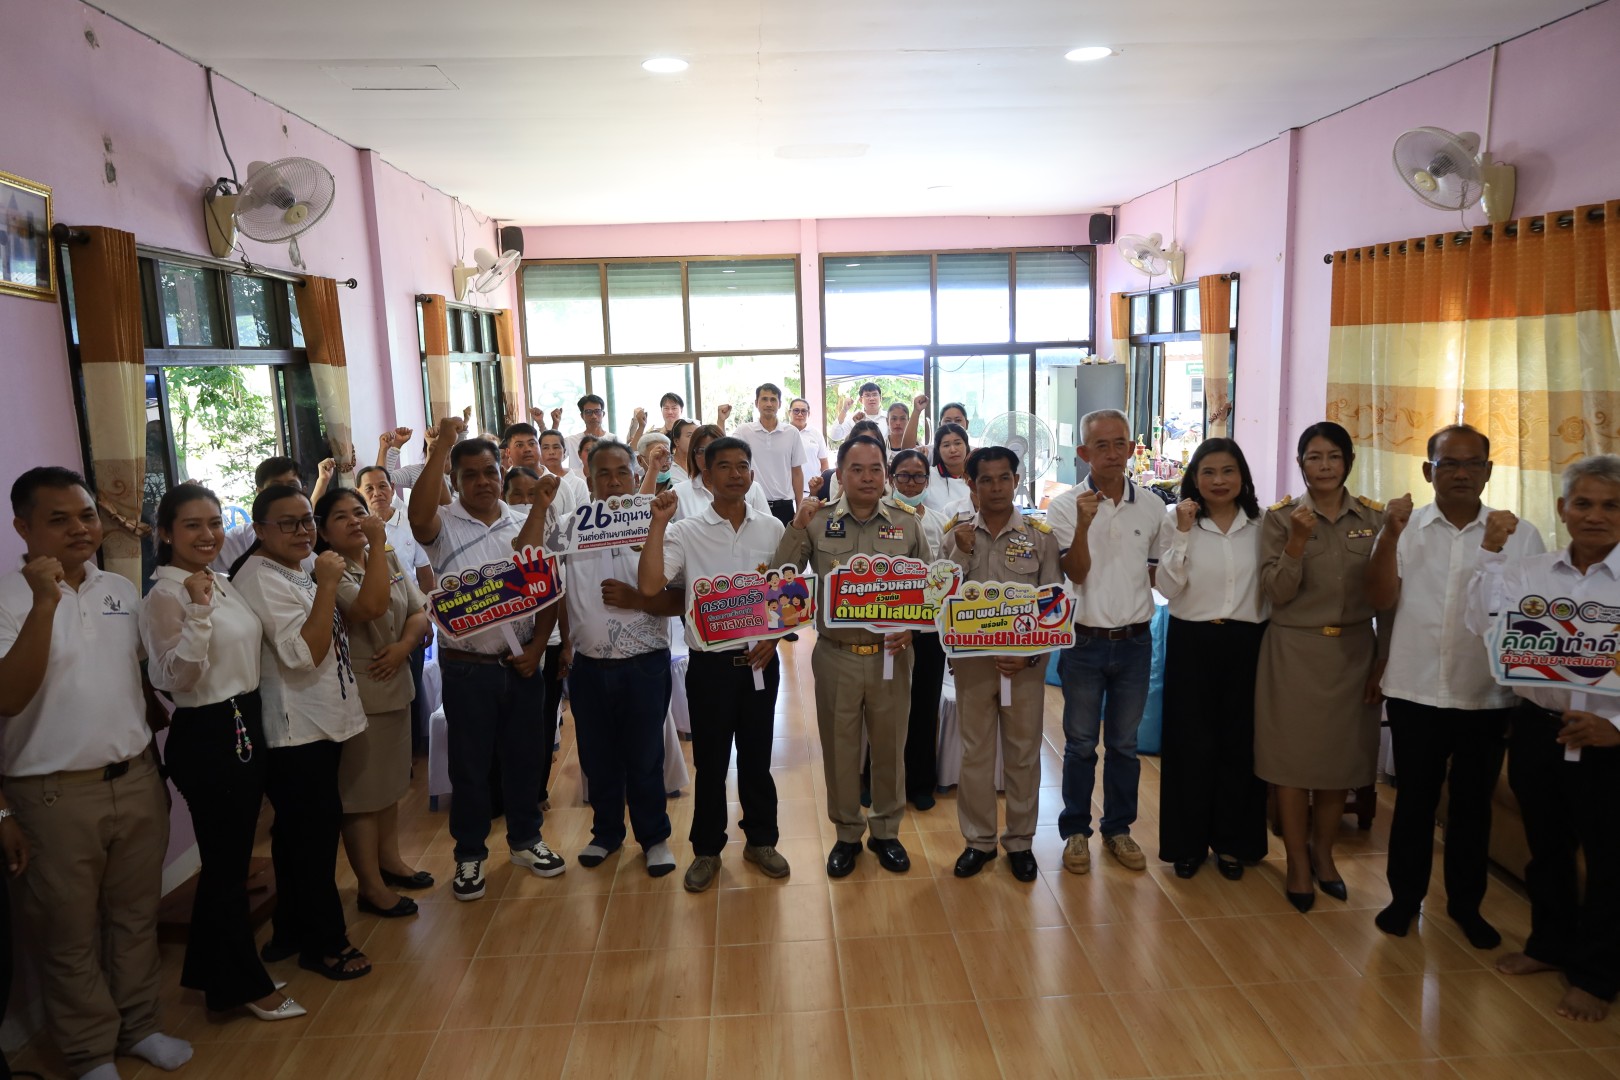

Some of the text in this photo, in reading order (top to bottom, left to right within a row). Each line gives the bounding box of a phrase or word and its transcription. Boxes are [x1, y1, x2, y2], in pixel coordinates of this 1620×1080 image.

[576, 503, 652, 531] 26 มิถุนาย
[436, 578, 505, 613] มุ่งมั่น แก้ไข
[528, 580, 547, 595] NO
[840, 578, 926, 596] รักลูกห่วงหลาน
[701, 589, 764, 614] ครอบครัว
[876, 593, 900, 602] ร่วมกัน
[450, 597, 537, 631] ยาเสพติด
[957, 610, 974, 620] คน
[709, 615, 764, 632] ยาเสพติด
[981, 619, 1008, 629] พร้อมใจ
[944, 628, 1072, 646] ต้านภัยยาเสพติด
[1502, 631, 1618, 652] คิดดี ทำดี
[1501, 651, 1616, 667] ต่อต้านยาเสพติด
